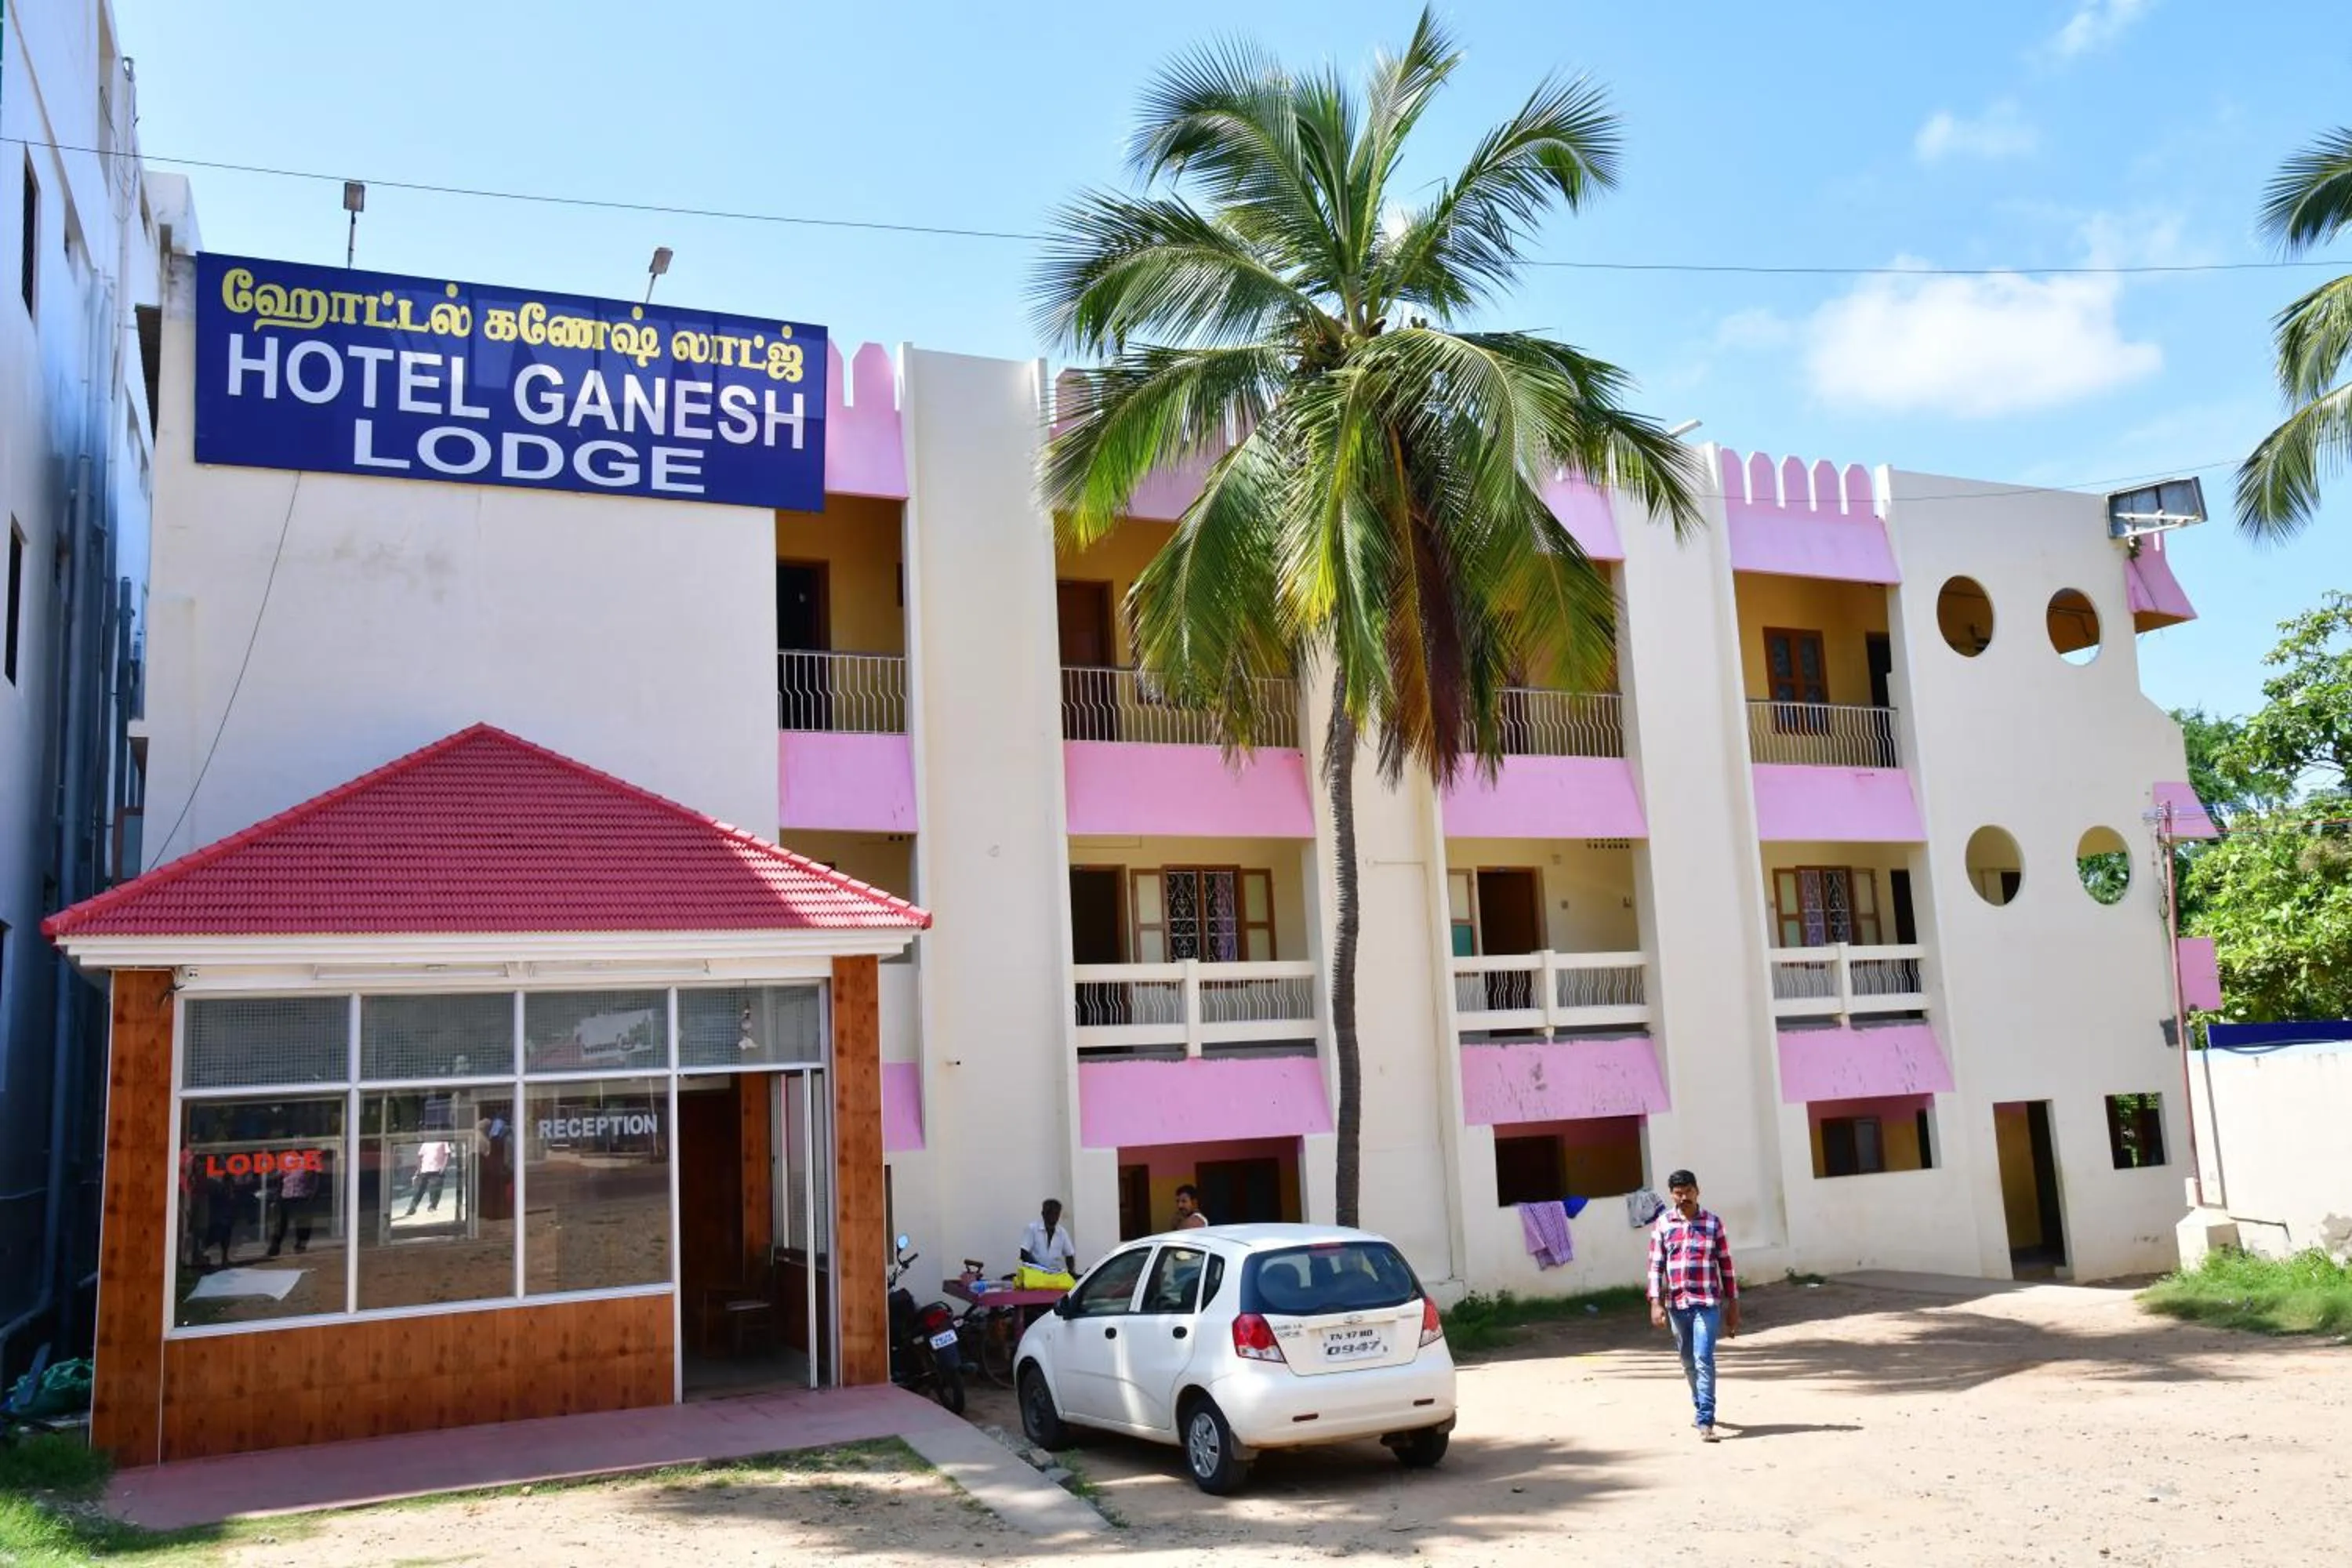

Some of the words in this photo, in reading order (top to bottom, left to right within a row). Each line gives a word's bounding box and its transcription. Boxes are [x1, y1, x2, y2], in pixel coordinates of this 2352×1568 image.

[222, 268, 471, 338] ஹோட்டல்
[484, 302, 659, 366] கணேஷ்
[671, 325, 804, 383] லாட்ஜ்
[227, 333, 490, 419] HOTEL
[514, 363, 805, 449] GANESH
[354, 419, 706, 493] LODGE
[538, 1113, 659, 1138] RECEPTION
[205, 1149, 324, 1178] LODGE
[1327, 1340, 1381, 1356] 0947
